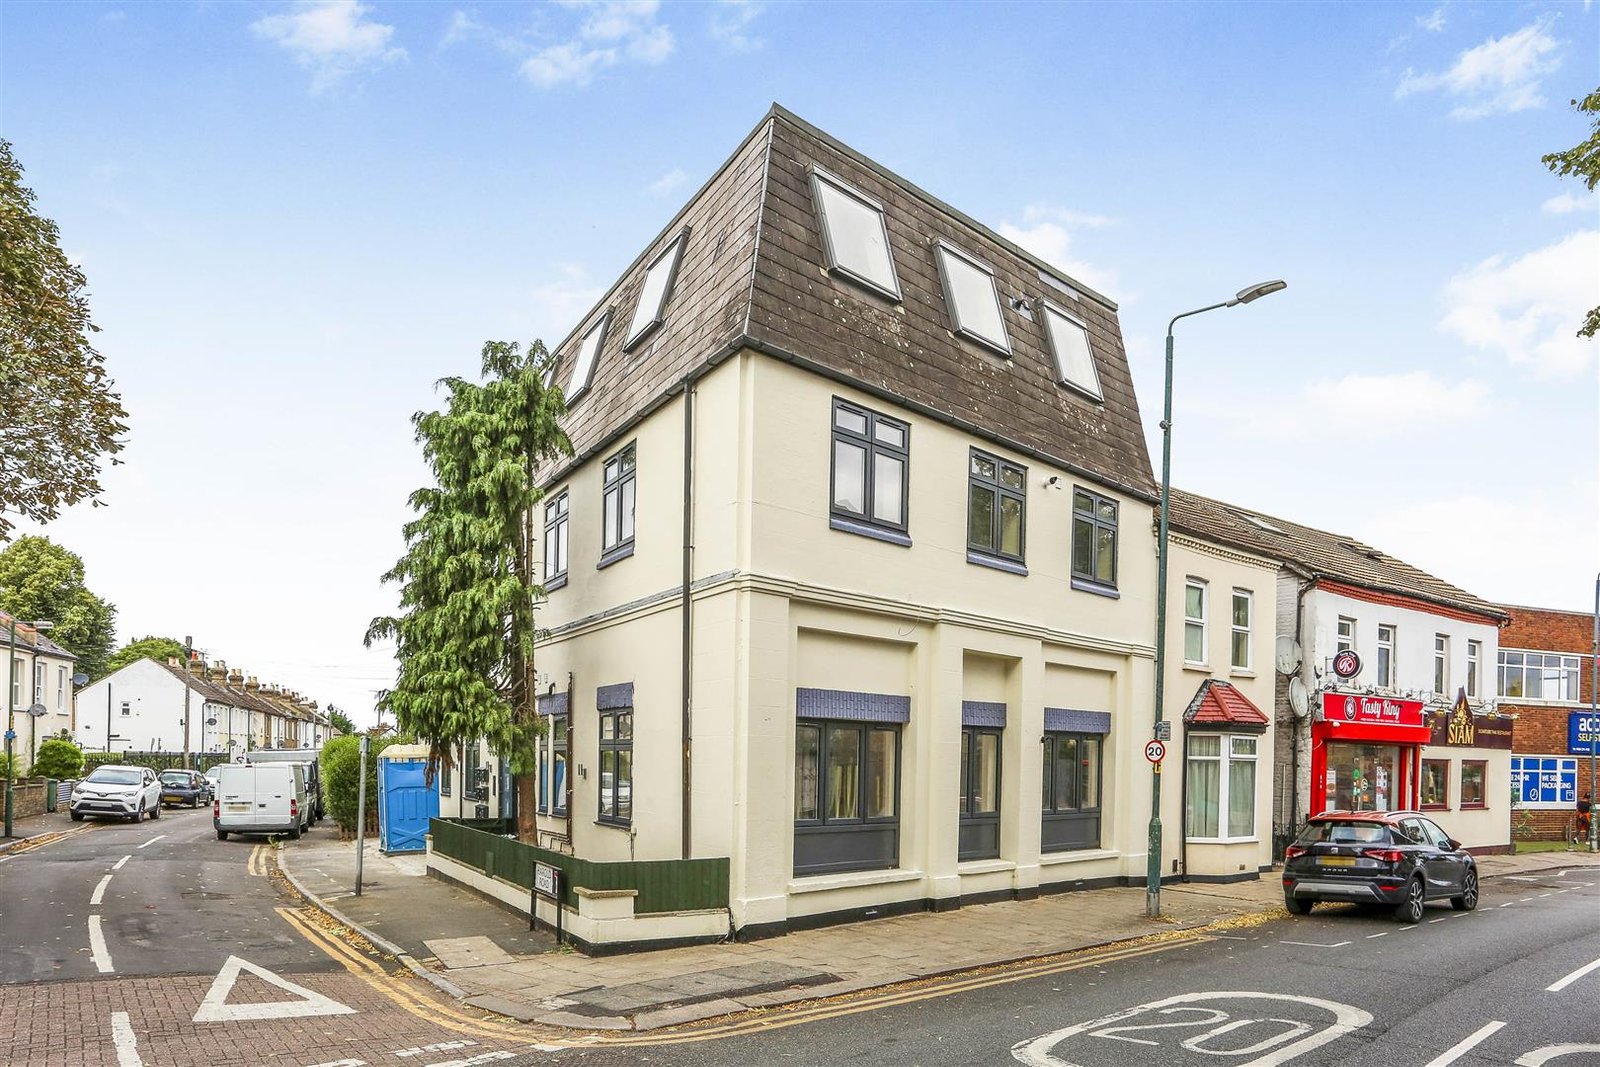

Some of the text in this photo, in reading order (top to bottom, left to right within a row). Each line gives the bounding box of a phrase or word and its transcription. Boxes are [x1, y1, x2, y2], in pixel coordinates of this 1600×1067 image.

[1361, 698, 1401, 720] Tasty King
[1448, 724, 1474, 744] SIAM
[1148, 747, 1162, 756] 20
[1089, 1007, 1311, 1056] 20
